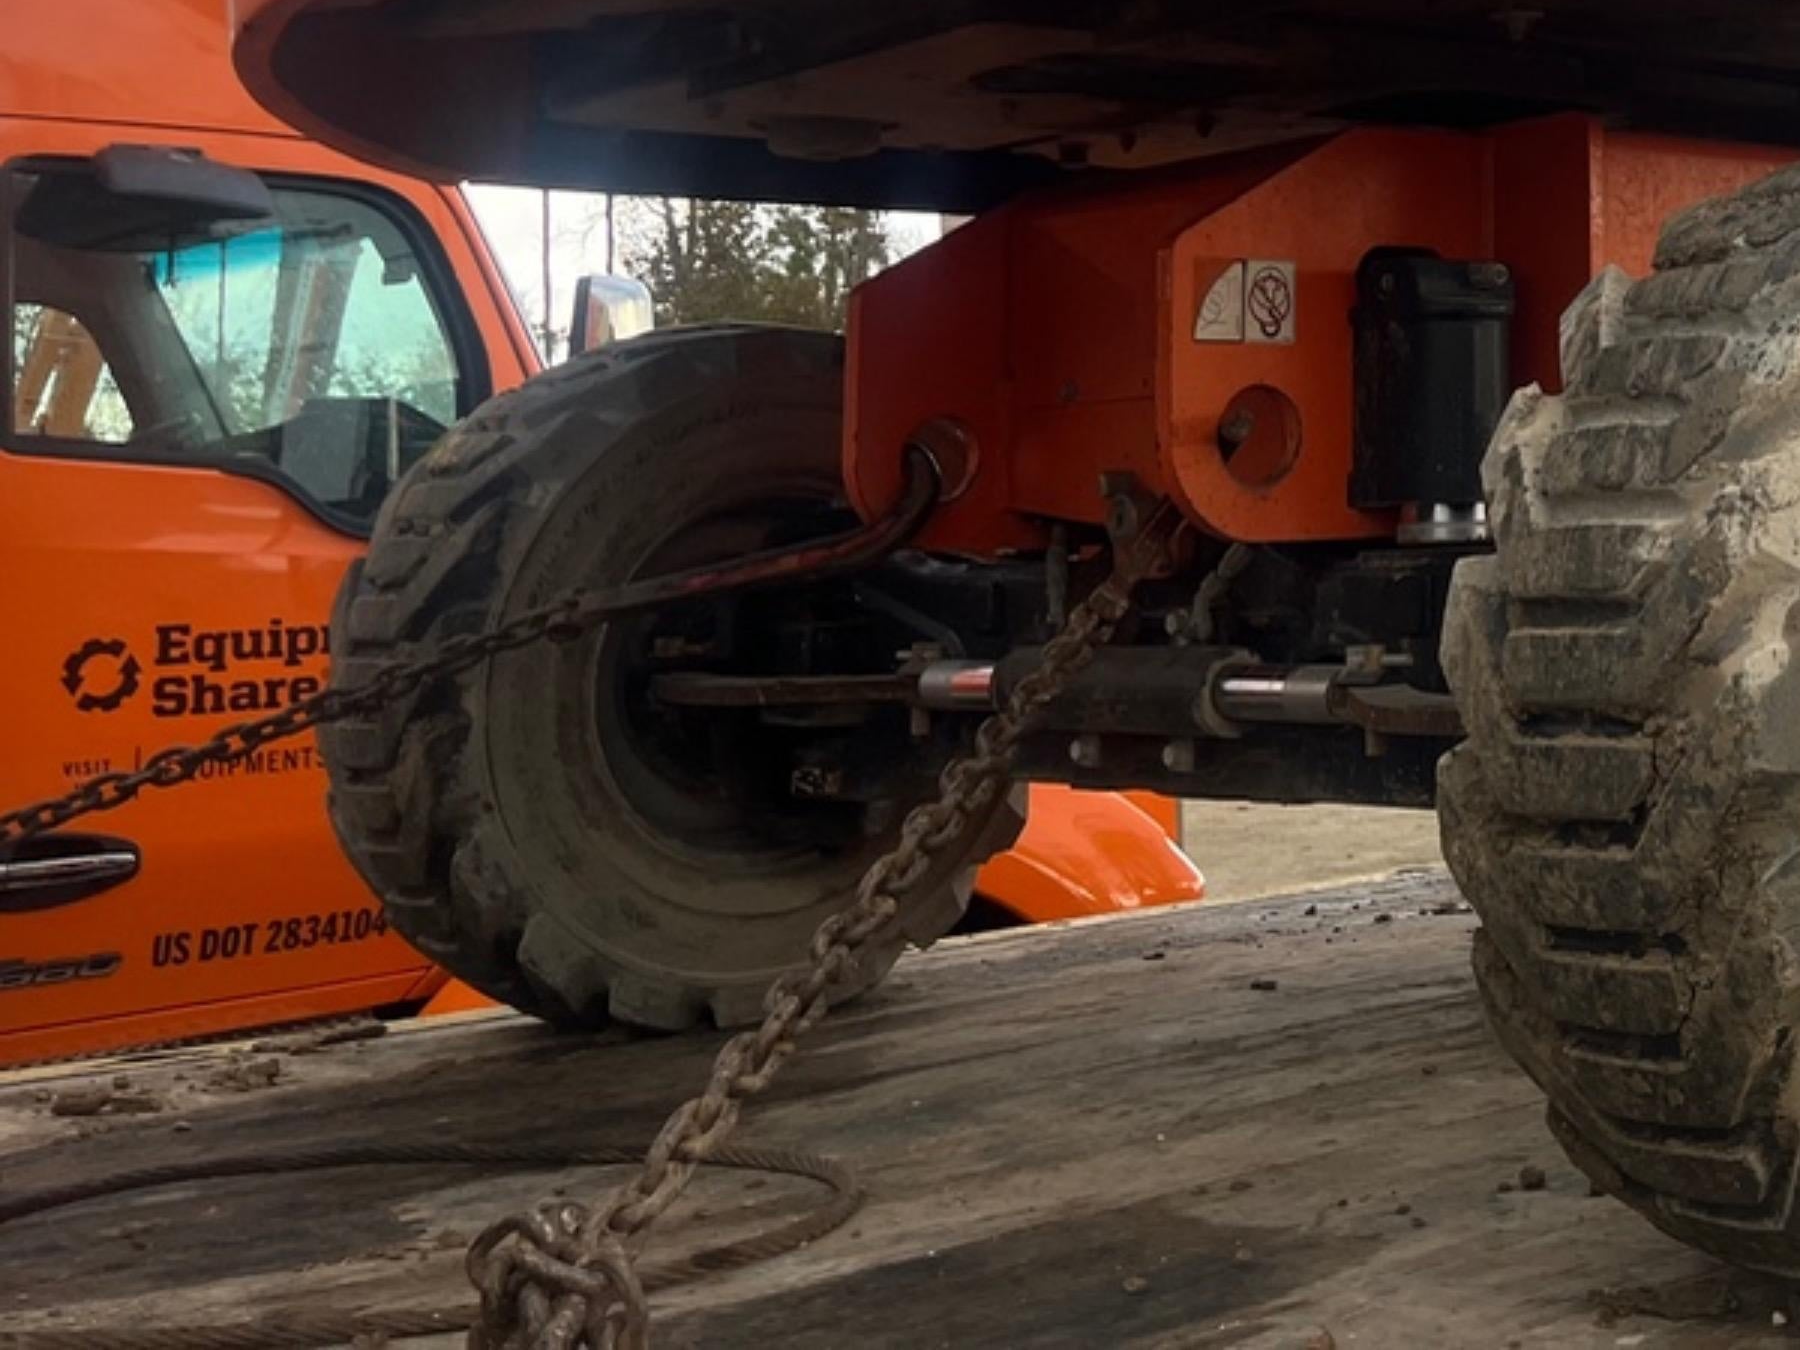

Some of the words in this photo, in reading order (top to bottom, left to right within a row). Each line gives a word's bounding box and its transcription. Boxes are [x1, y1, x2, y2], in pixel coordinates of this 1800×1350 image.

[152, 674, 318, 717] Share
[63, 759, 111, 776] VISIT
[152, 932, 191, 967] US
[198, 923, 259, 961] DOT
[263, 906, 388, 952] 2834104
